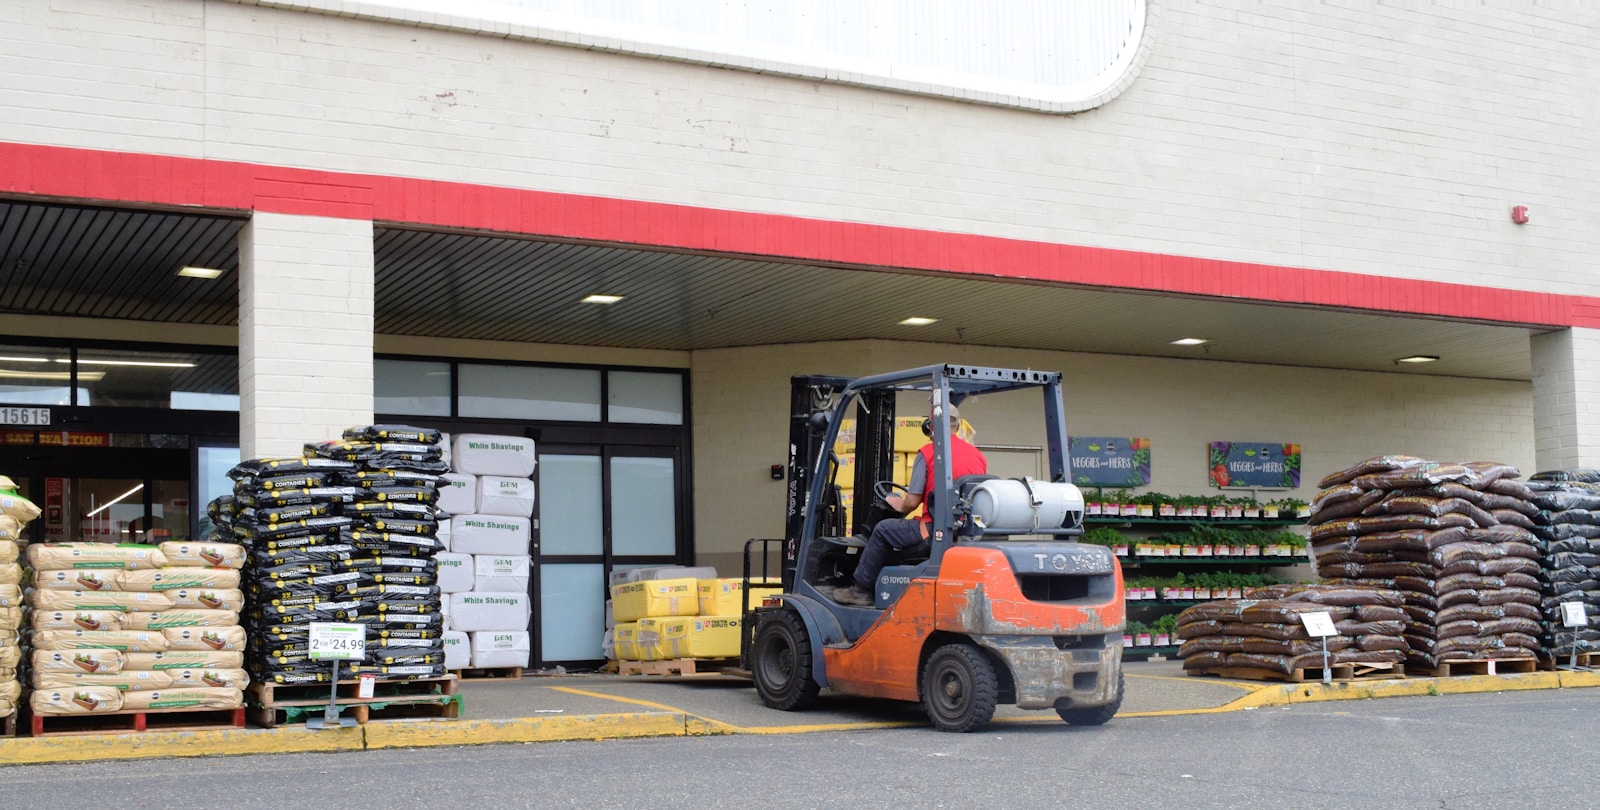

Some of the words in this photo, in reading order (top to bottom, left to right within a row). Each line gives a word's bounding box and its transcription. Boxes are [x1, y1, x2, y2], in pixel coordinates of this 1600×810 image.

[2, 408, 49, 424] 15615
[6, 433, 102, 445] SATSFATION
[491, 443, 524, 452] Shavings
[1072, 457, 1100, 468] VEGGIES
[1109, 457, 1131, 468] HERBS
[1230, 461, 1255, 472] VEGGIES
[1262, 462, 1283, 472] HERBS
[788, 480, 798, 517] YOTA
[280, 509, 311, 519] CONTAINER
[487, 521, 520, 531] Shavings
[278, 539, 309, 547] CONTAINER
[1034, 553, 1111, 570] TOYOTA
[280, 568, 310, 577] CONTAINER
[486, 597, 518, 605] Shavings
[312, 639, 319, 649] 2
[330, 639, 364, 650] $24.99
